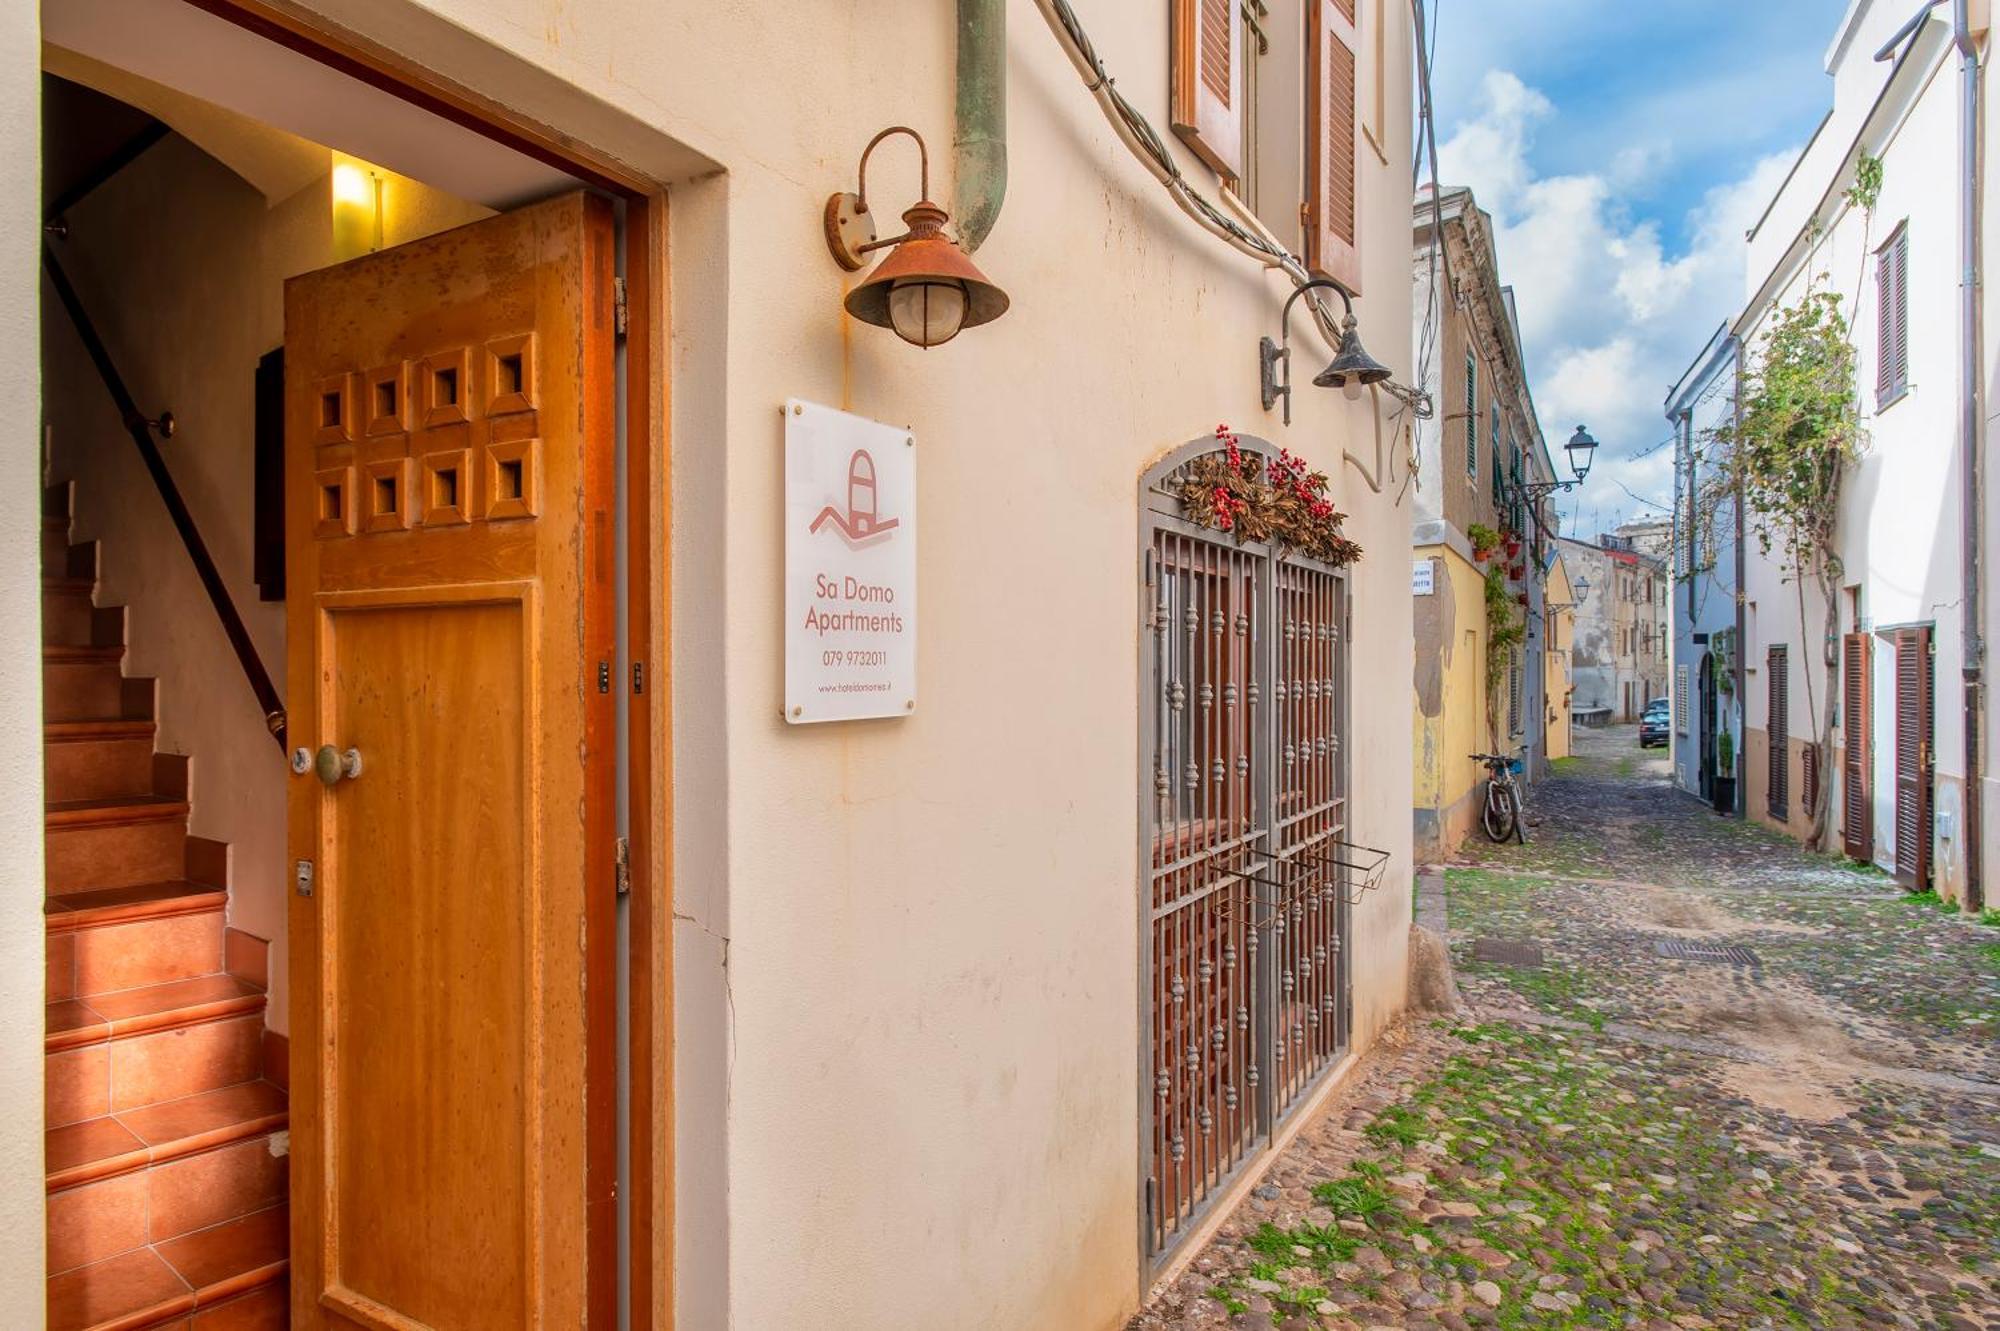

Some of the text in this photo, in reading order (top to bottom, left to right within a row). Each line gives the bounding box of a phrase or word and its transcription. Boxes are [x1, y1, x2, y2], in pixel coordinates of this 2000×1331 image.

[816, 573, 894, 603] Sa Domo
[805, 605, 903, 637] Apartments
[822, 650, 886, 667] 079 9732011
